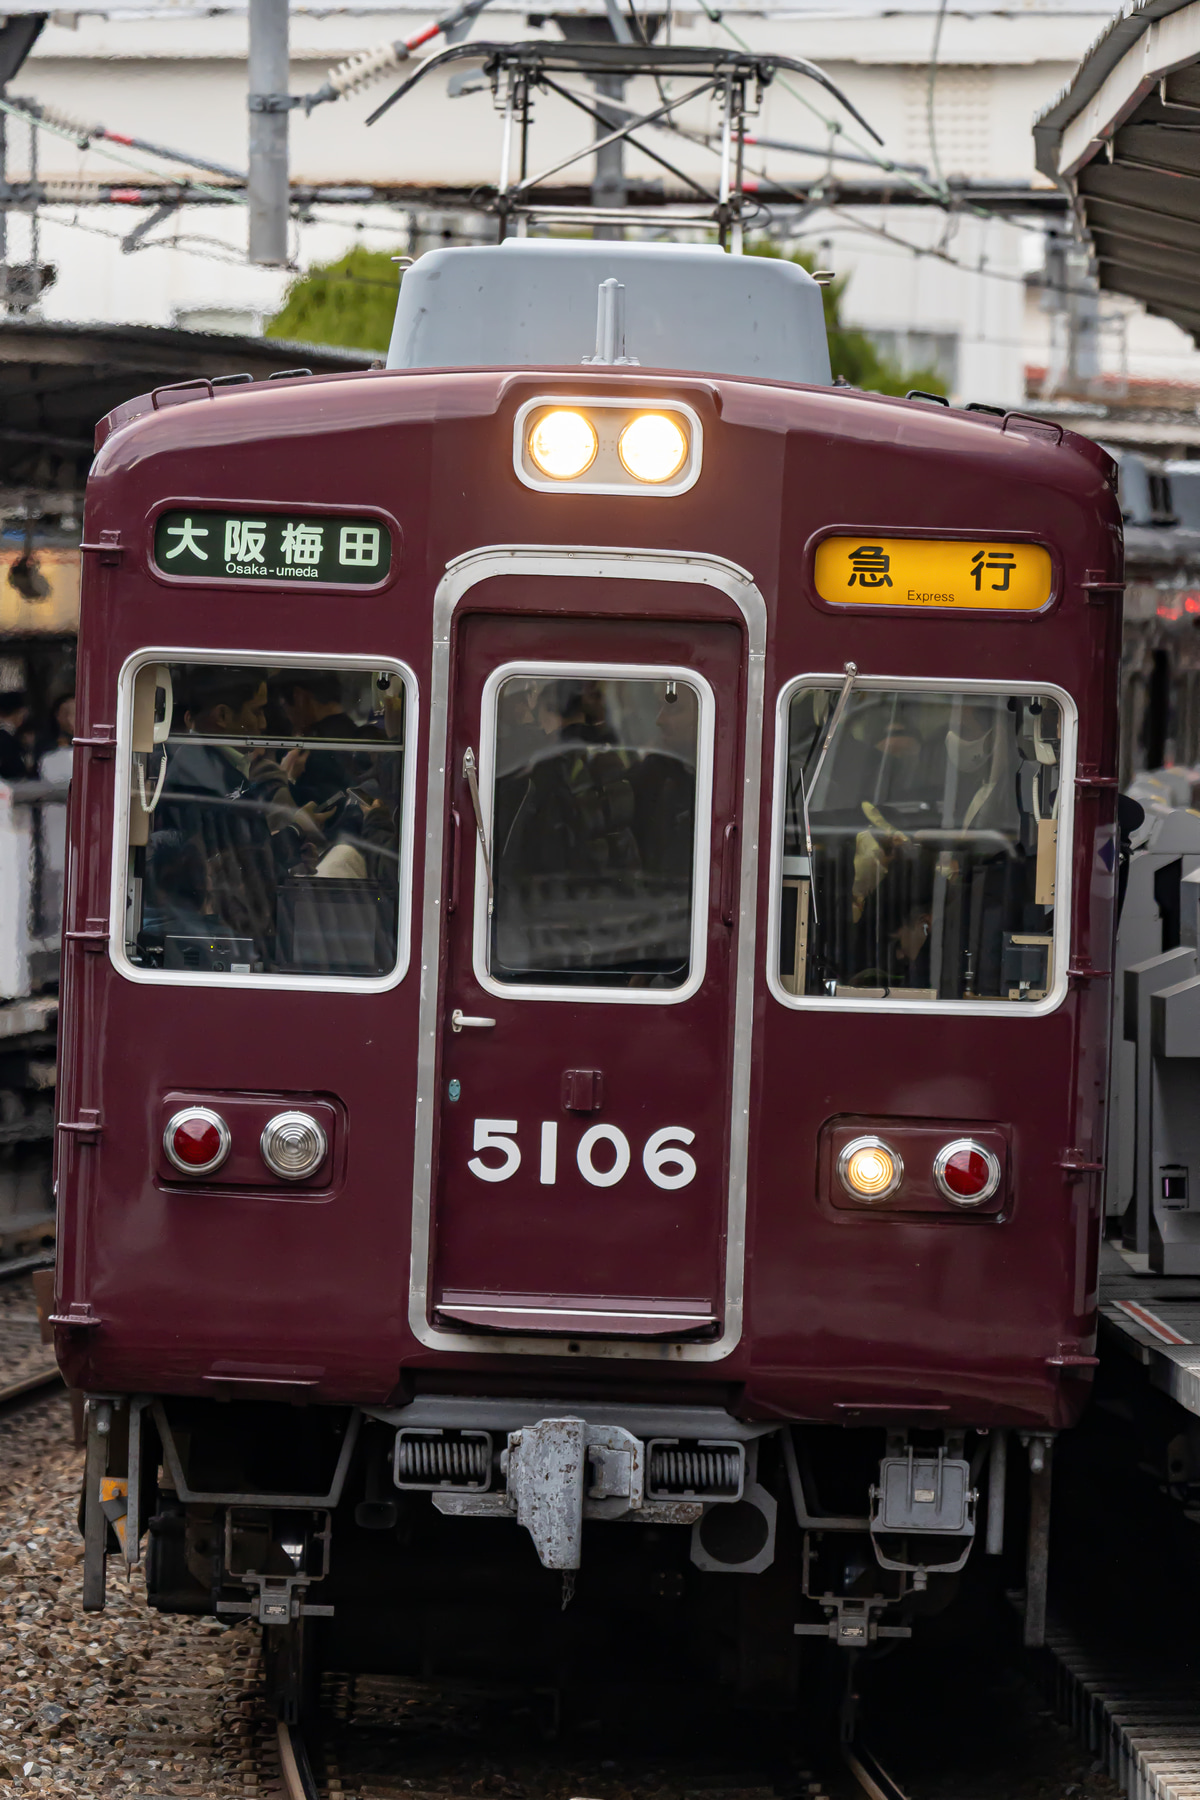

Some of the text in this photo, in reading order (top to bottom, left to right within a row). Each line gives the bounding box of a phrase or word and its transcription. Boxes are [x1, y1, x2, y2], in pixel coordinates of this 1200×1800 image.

[165, 518, 381, 567] 大阪梅田
[225, 562, 320, 578] Osaka-umeda
[906, 589, 956, 602] Express
[467, 1118, 697, 1190] 5106
